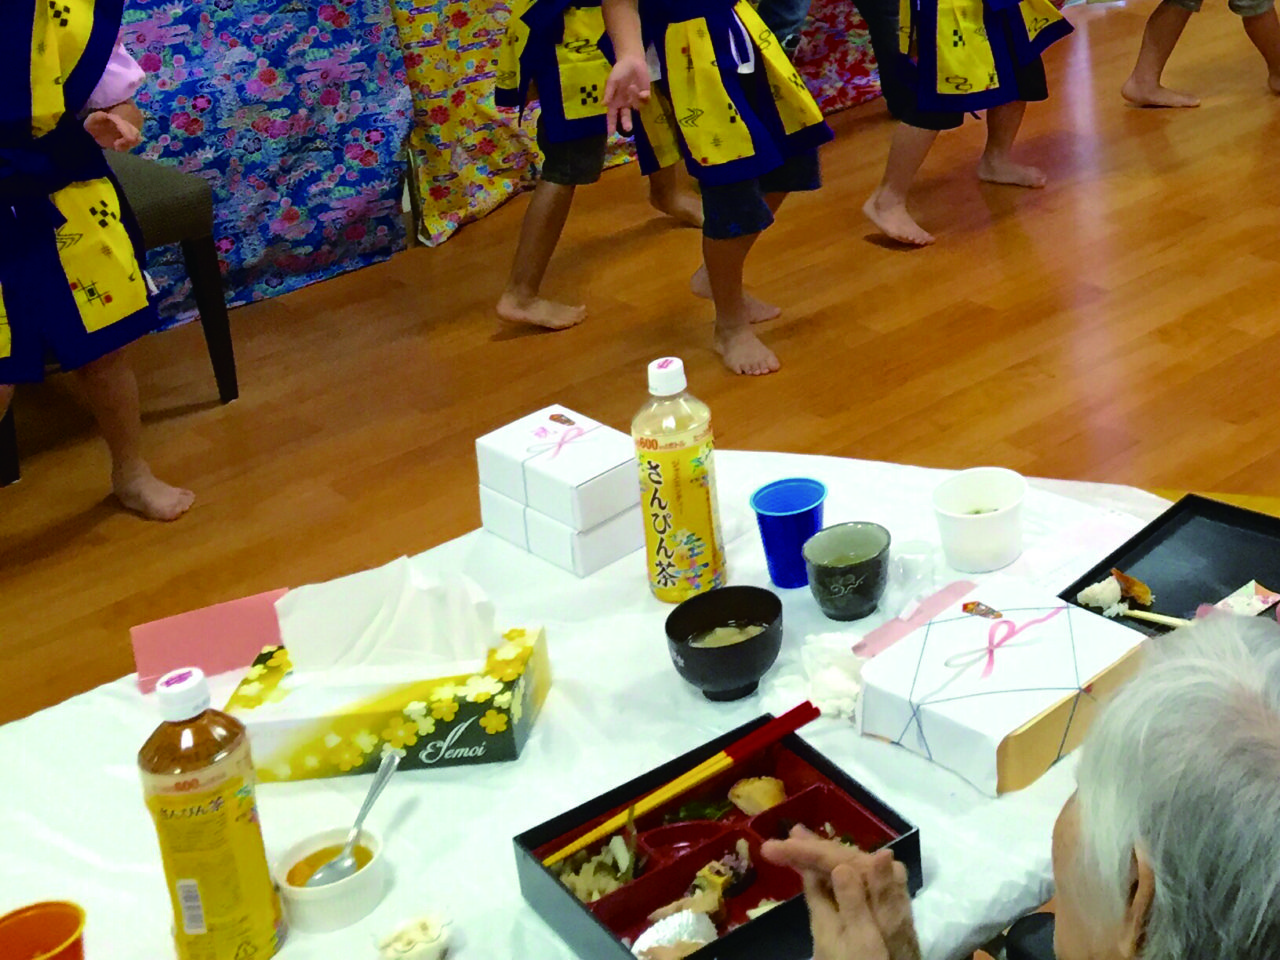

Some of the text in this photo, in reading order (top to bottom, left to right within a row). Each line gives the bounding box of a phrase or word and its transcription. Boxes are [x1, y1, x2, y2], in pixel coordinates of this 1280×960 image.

[647, 460, 680, 588] さんぴん茶
